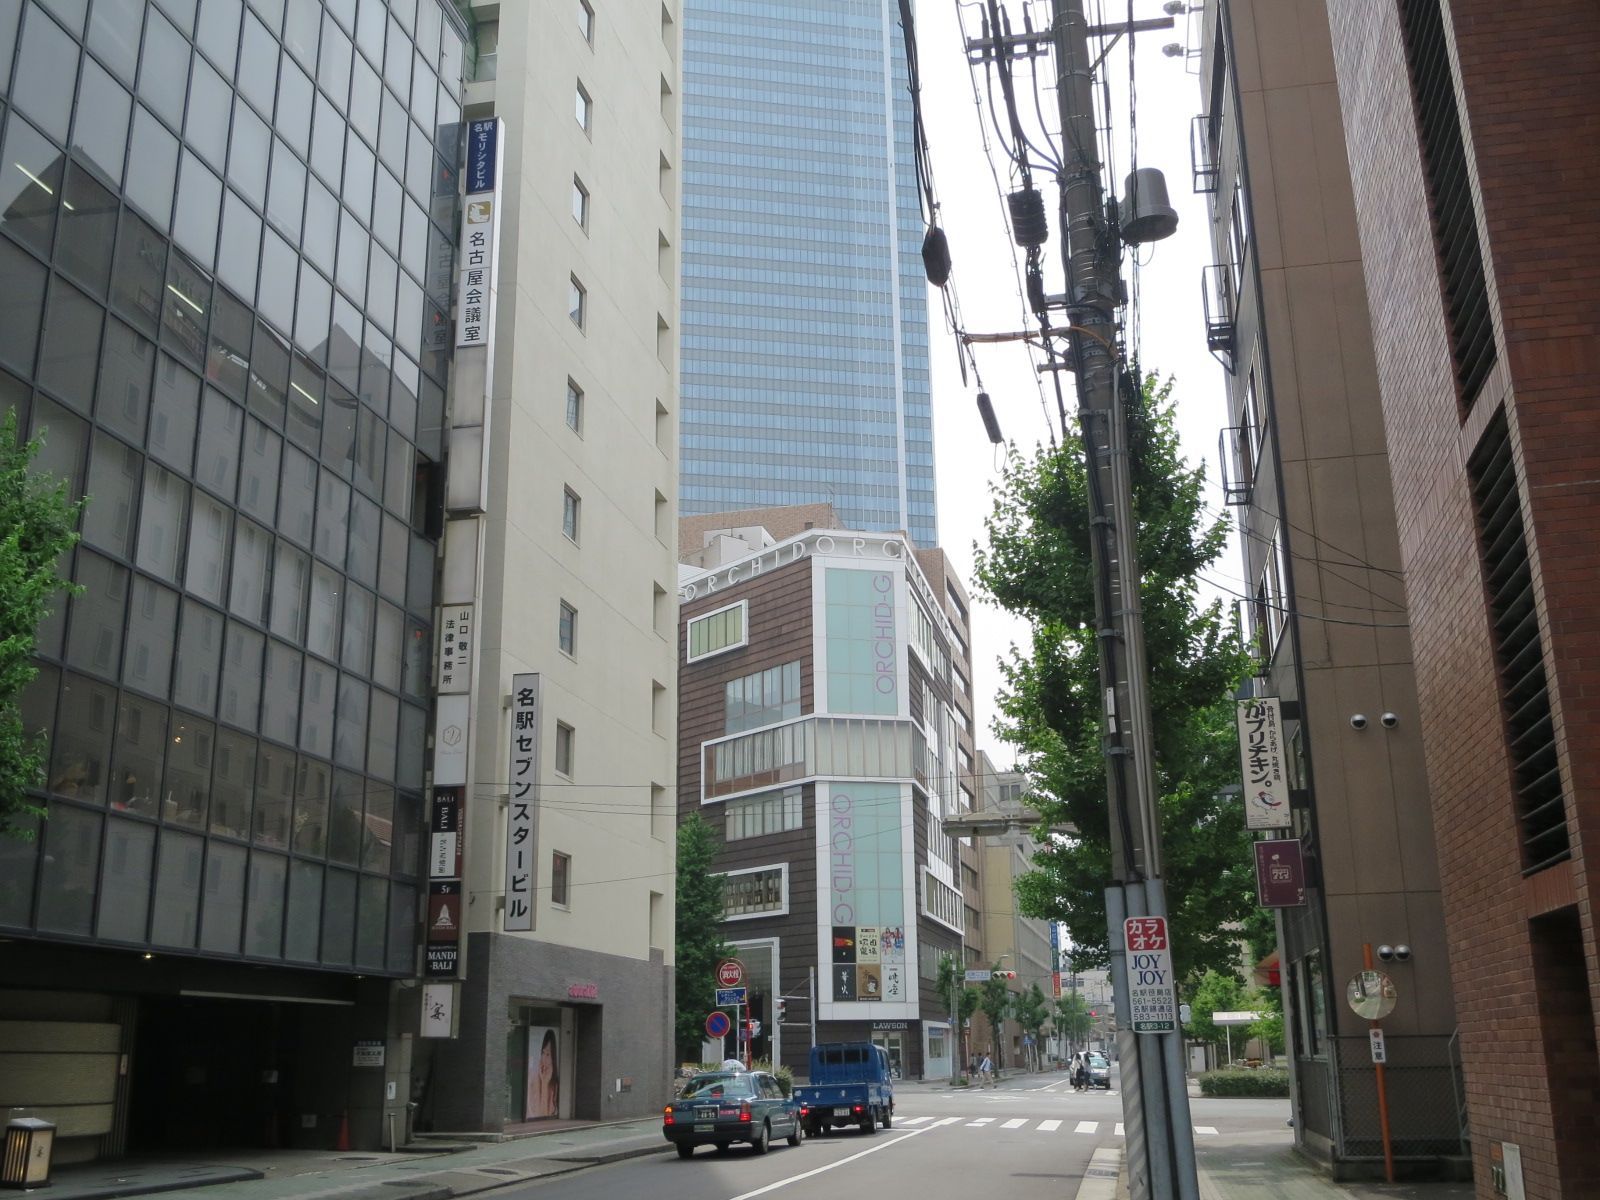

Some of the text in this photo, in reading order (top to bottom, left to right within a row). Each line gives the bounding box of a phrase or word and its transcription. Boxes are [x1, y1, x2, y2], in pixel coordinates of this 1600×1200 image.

[473, 121, 493, 132] 名駅
[475, 132, 488, 189] モリシタビル
[464, 231, 485, 342] 名古屋会議室
[685, 541, 805, 601] ORCHID
[442, 620, 455, 684] 法律事務所
[458, 611, 469, 665] 山口敬二
[873, 575, 895, 695] ORCHID-G
[509, 687, 535, 918] 名駅セブンスタービル
[832, 794, 854, 925] ORCHID-G
[1128, 919, 1159, 935] カラ
[1133, 935, 1164, 949] オケ
[428, 951, 457, 960] MANDI
[1131, 954, 1161, 970] JOY
[1137, 970, 1167, 985] JOY
[1133, 1013, 1173, 1021] 583-1113
